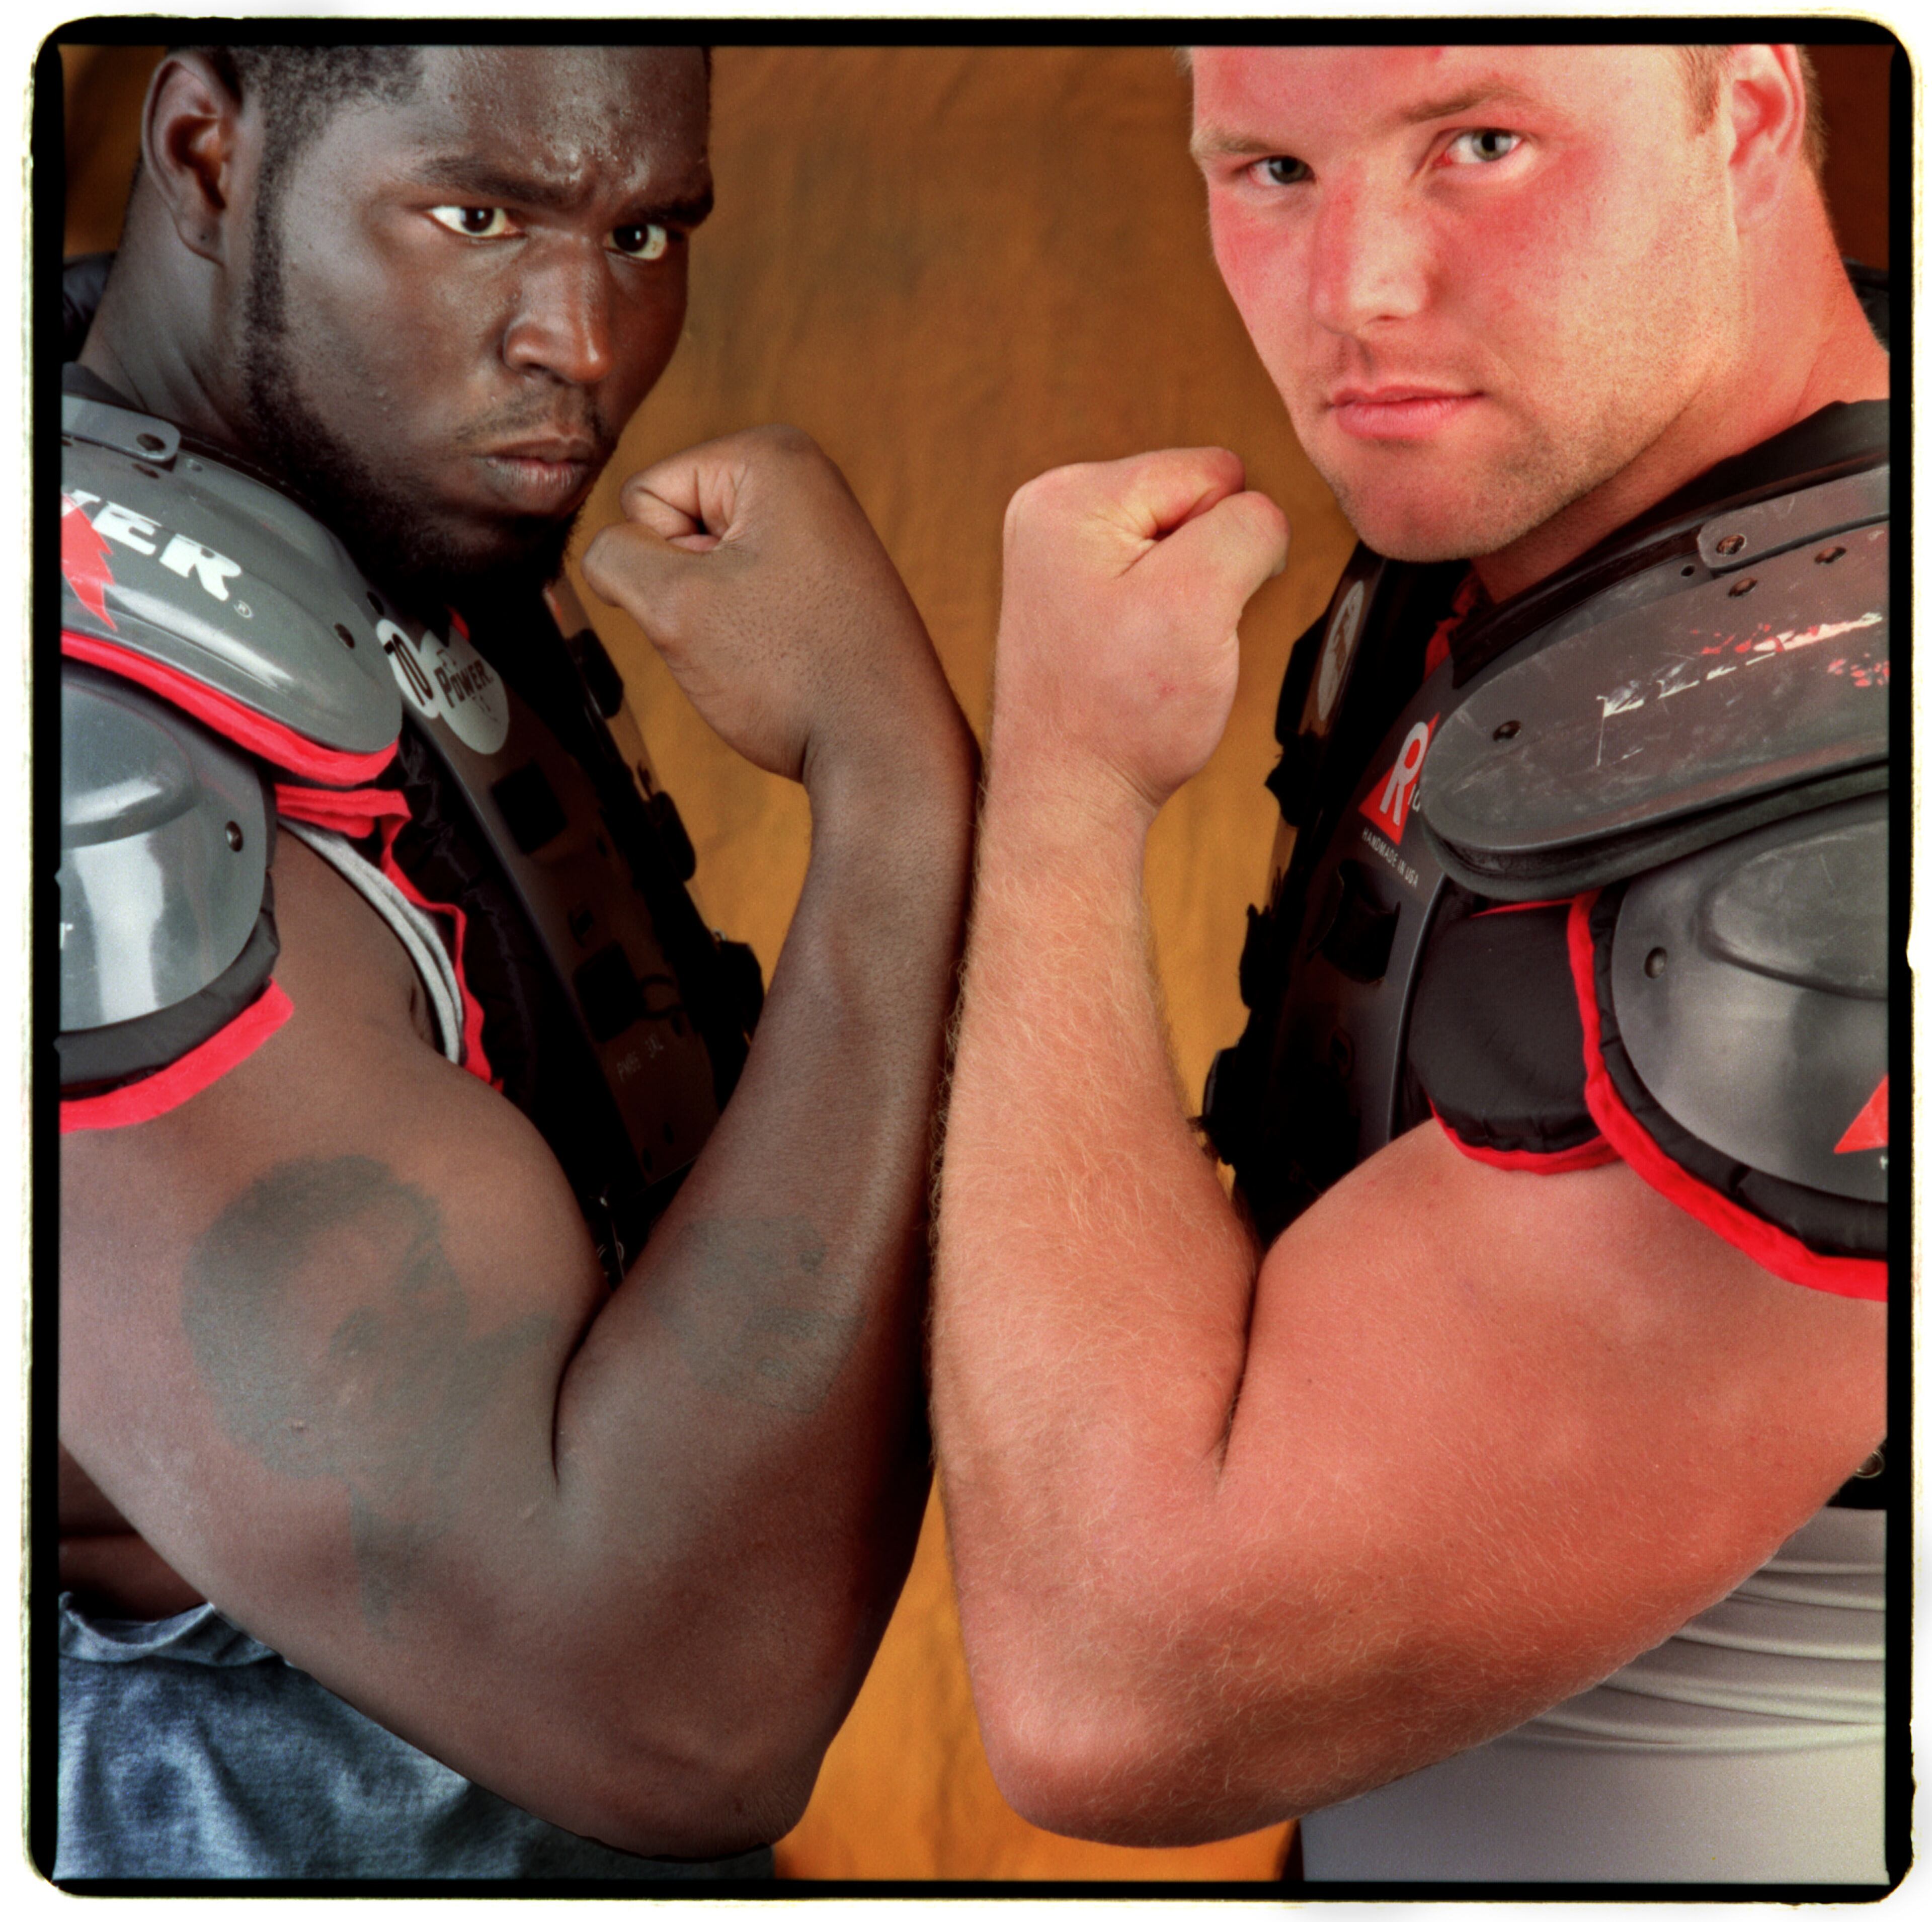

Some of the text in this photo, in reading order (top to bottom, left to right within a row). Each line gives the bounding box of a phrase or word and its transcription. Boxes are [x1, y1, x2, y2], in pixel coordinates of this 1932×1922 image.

[1362, 827, 1419, 888] HANDMADE IN USA
